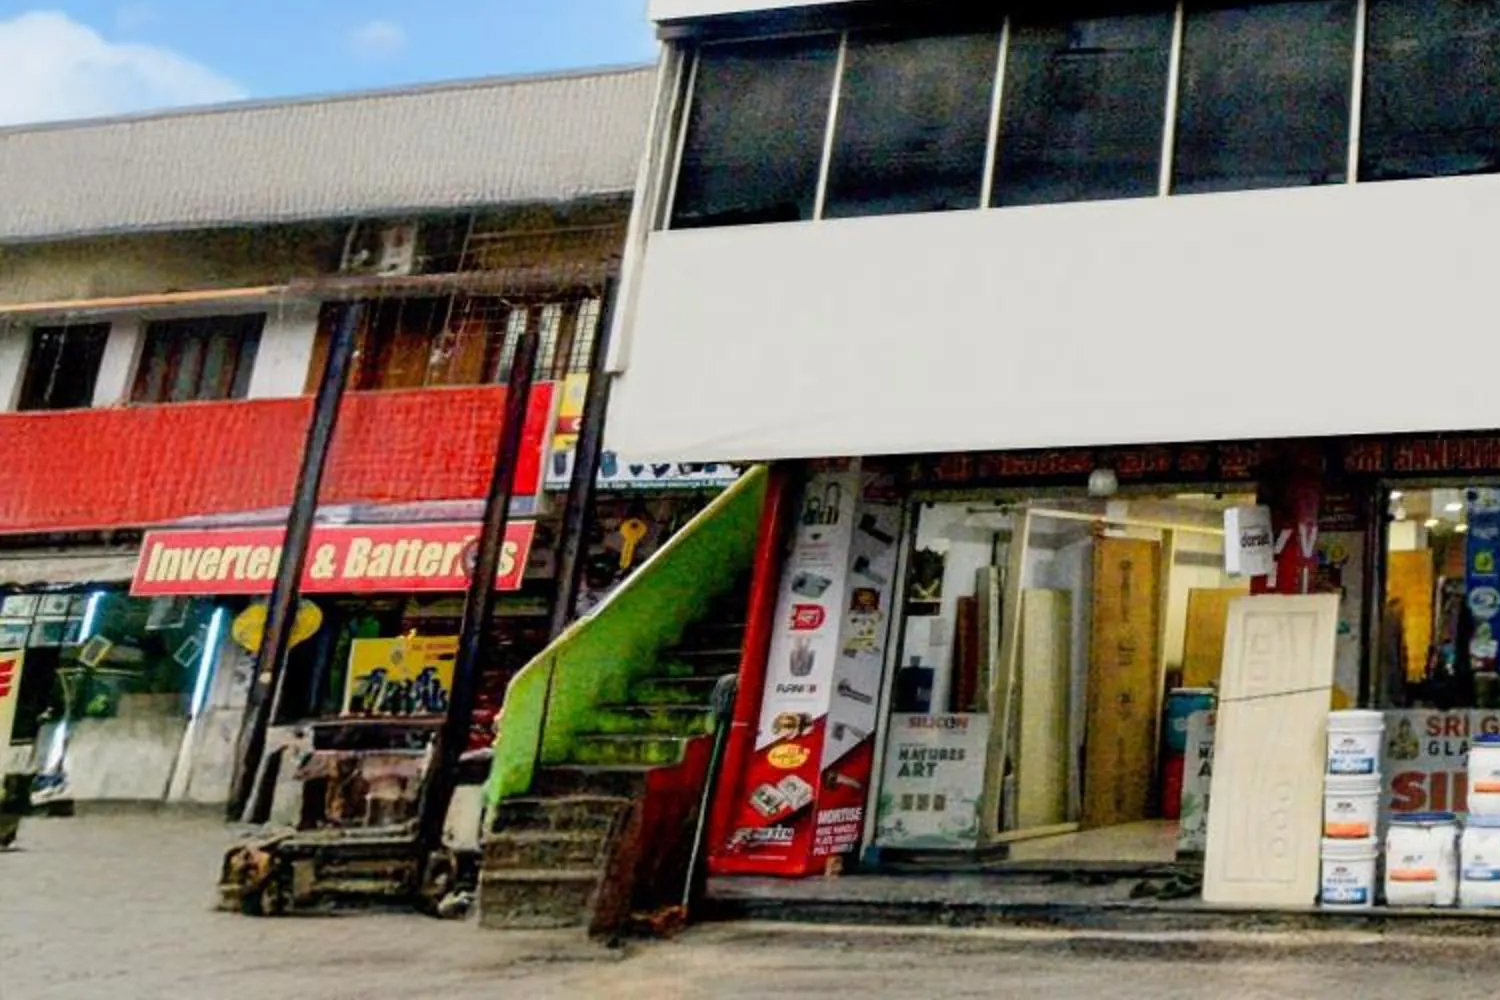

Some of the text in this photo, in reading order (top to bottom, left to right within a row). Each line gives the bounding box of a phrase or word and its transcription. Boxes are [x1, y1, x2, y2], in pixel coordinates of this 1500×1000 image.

[310, 542, 336, 580] &
[343, 534, 518, 579] Batteris
[1427, 715, 1469, 738] SRI
[899, 747, 967, 761] NATURES
[898, 762, 938, 779] ART
